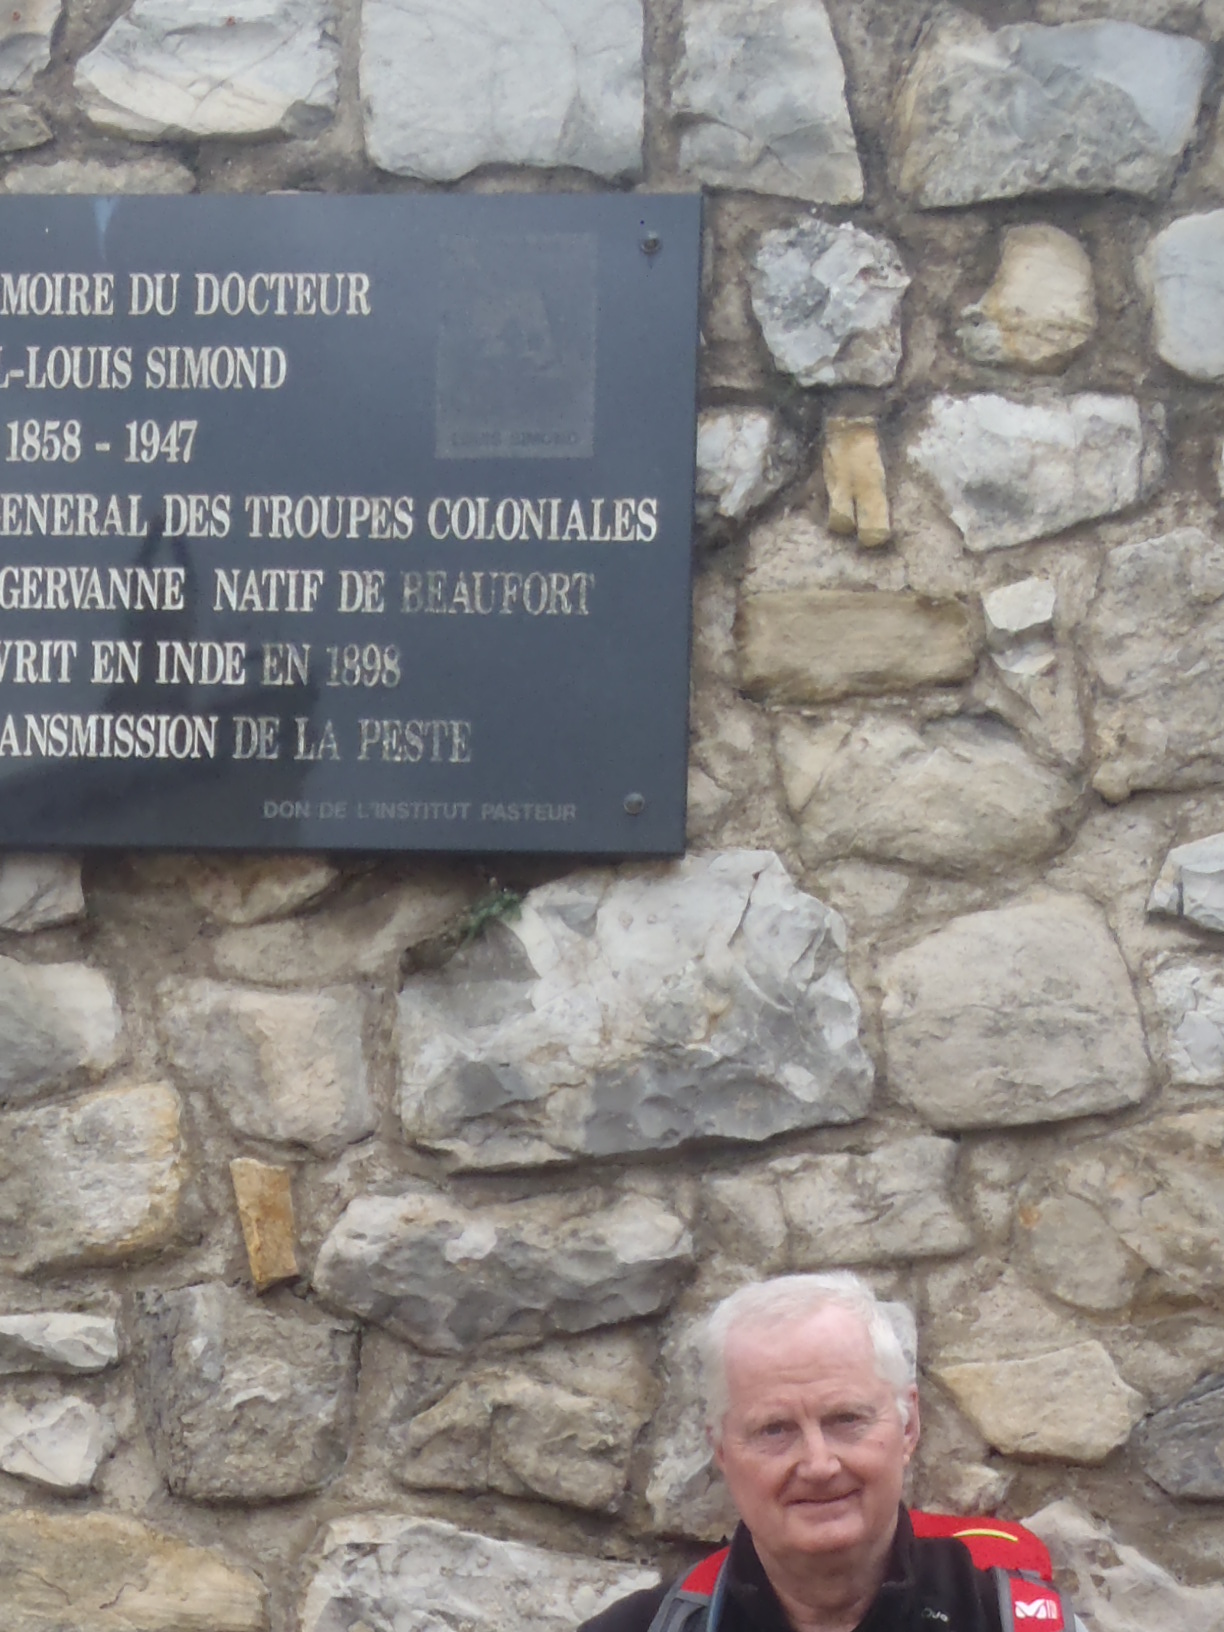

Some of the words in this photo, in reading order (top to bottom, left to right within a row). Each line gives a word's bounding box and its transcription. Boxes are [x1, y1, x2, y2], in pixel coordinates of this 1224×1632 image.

[128, 272, 181, 317] DU
[194, 272, 372, 317] DOCTEUR
[145, 346, 288, 390] SIMOND
[5, 419, 82, 463] 1858
[95, 441, 111, 452] -
[125, 419, 199, 464] 1947
[161, 493, 232, 539] DES
[244, 494, 415, 541] TROUPES
[427, 496, 659, 543] COLONIALES
[212, 567, 325, 613] NATIF
[337, 569, 386, 614] DE
[400, 570, 596, 616] BEAUFORT
[89, 640, 143, 685] EN
[154, 640, 248, 686] INDE
[260, 642, 312, 686] EN
[325, 643, 402, 688] 1898
[231, 715, 281, 760] DE
[293, 716, 341, 761] LA
[357, 718, 472, 763] PESTE
[263, 801, 311, 819] DON
[318, 802, 347, 820] DE
[357, 802, 472, 820] L'INSTITUT
[480, 803, 577, 822] PASTEUR
